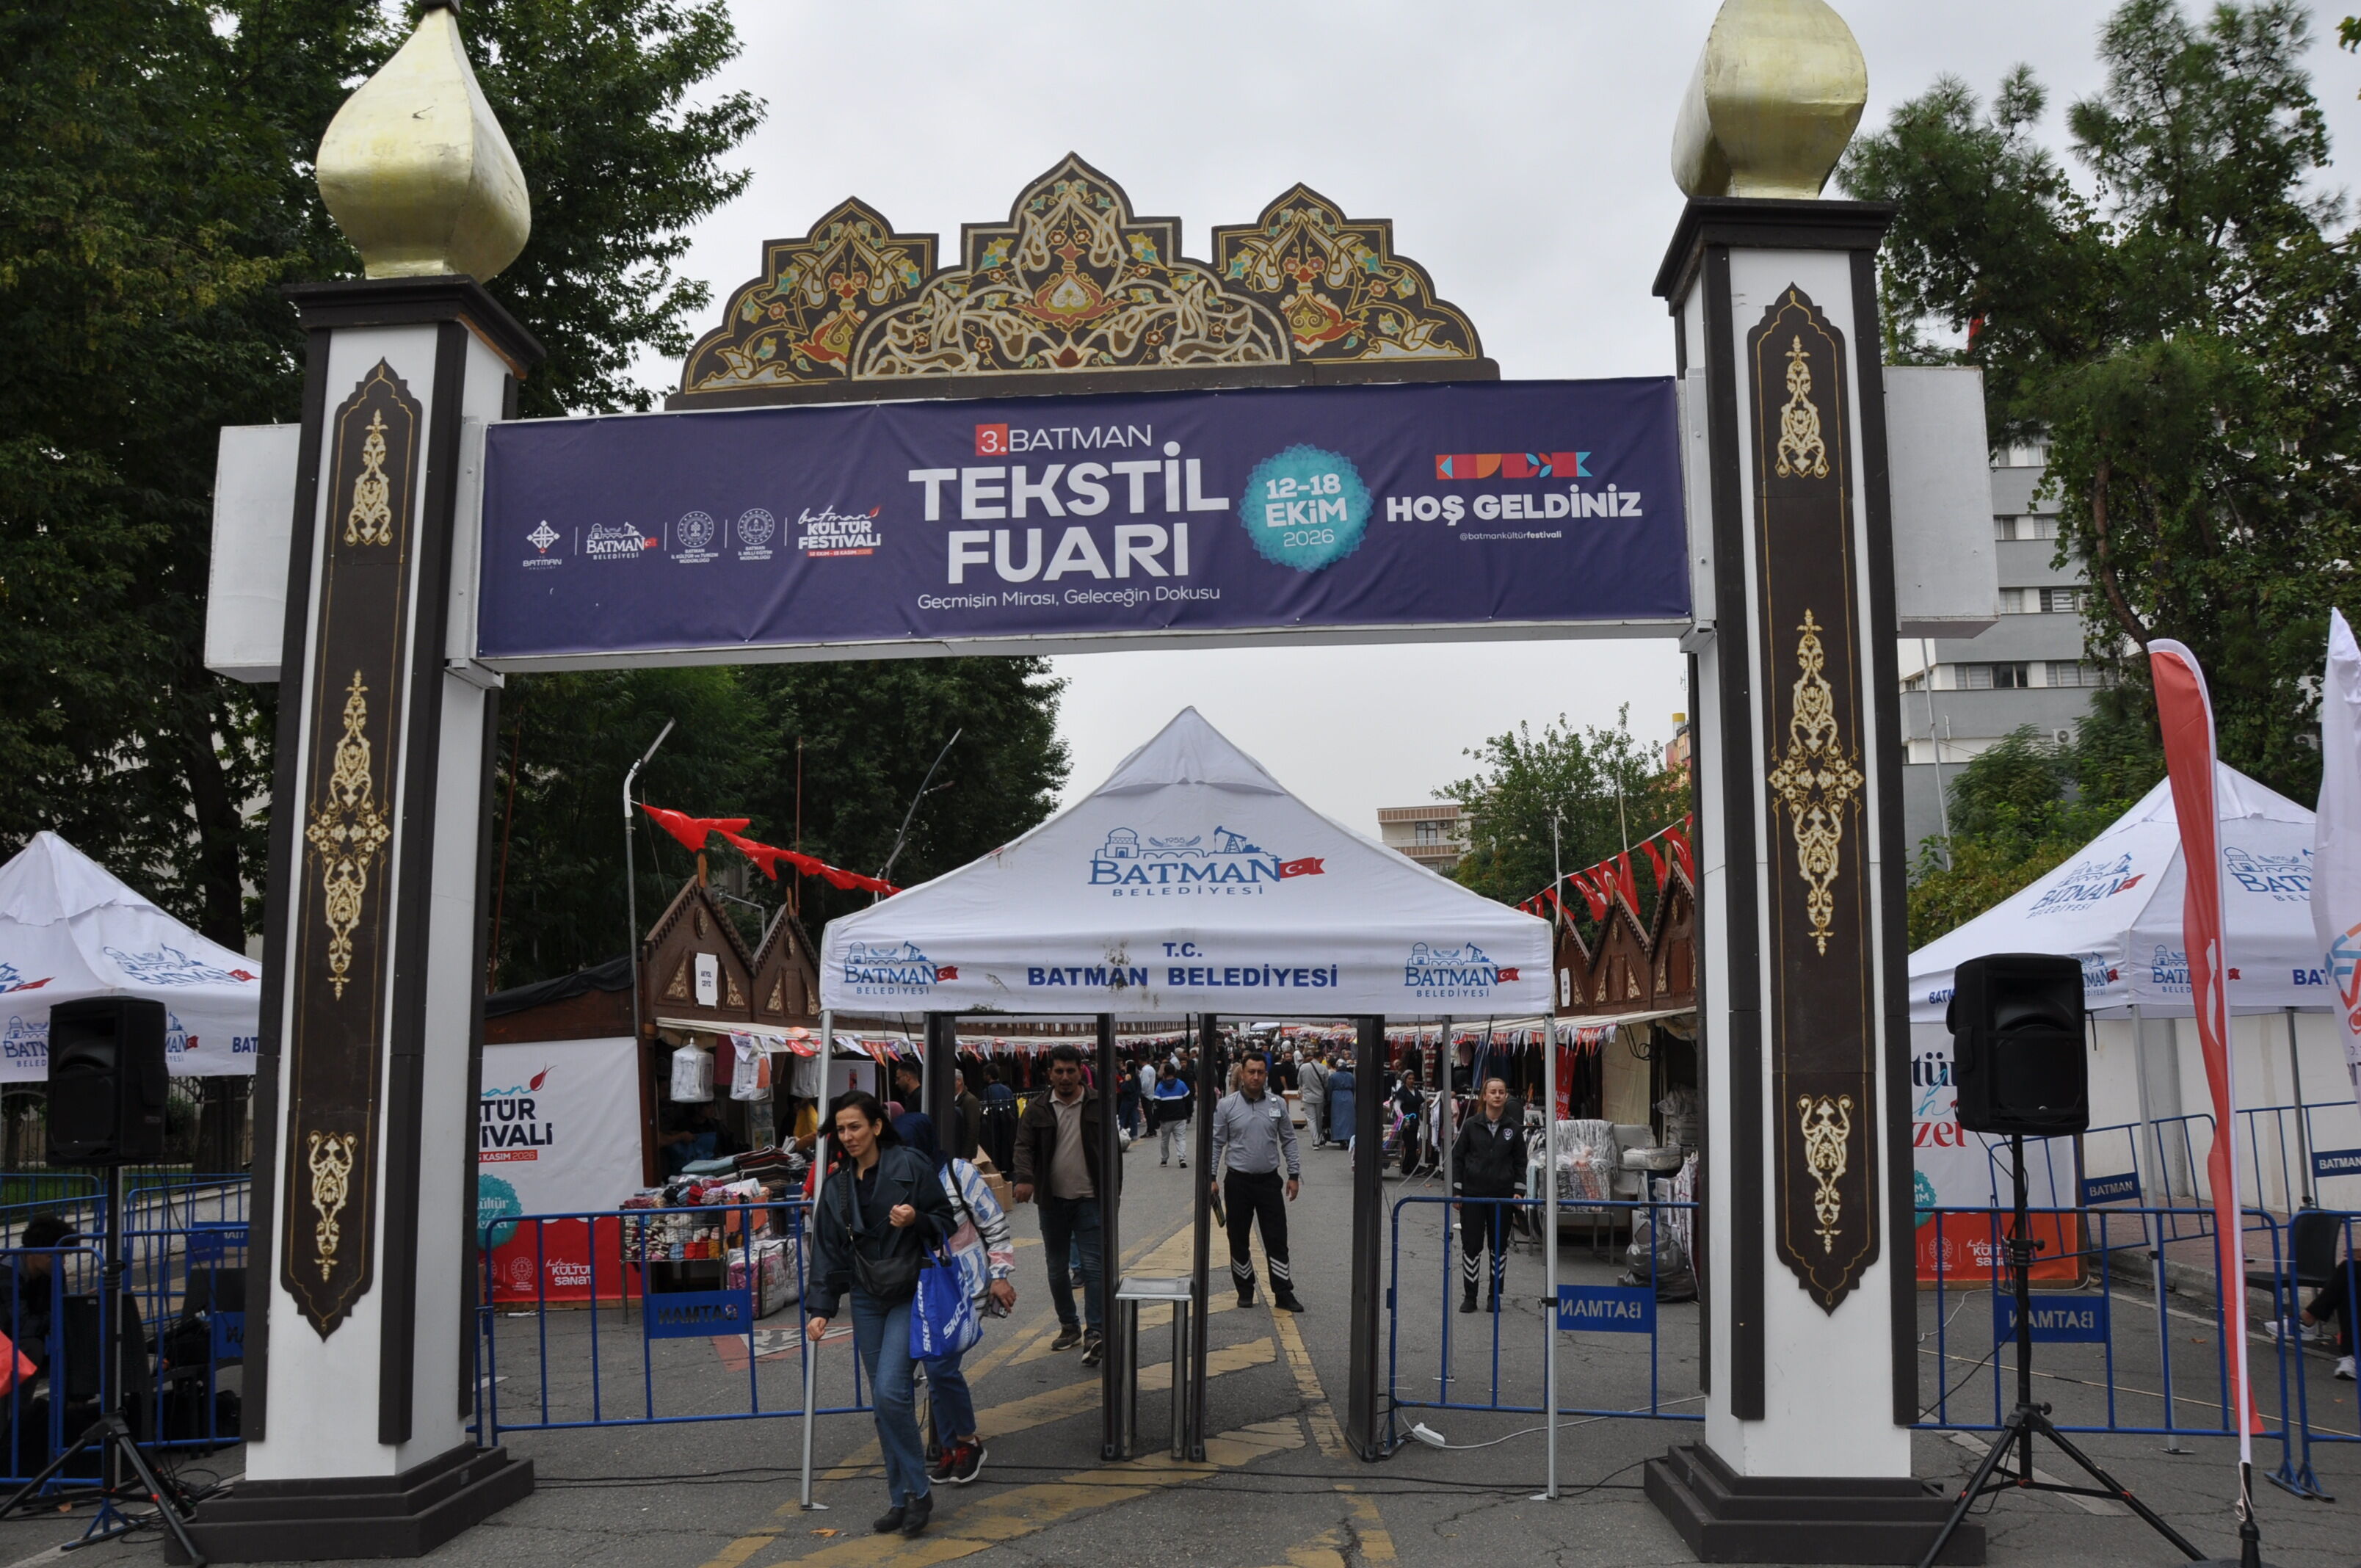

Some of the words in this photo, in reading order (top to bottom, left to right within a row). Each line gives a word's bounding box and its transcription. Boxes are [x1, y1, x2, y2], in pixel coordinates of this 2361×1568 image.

[909, 441, 1230, 520] TEKSTİL
[1266, 473, 1341, 499] 12-18
[1387, 495, 1465, 526] HOŞ
[1473, 483, 1642, 519] GELDİNİZ
[798, 505, 871, 524] batman
[808, 520, 872, 536] KÜLTÜR
[1459, 531, 1562, 540] @batmankültürfestivali
[586, 537, 645, 553] BATMAN
[1283, 529, 1334, 547] 2026
[948, 523, 1189, 584] FUARI
[523, 559, 562, 567] BATMAN
[918, 594, 996, 609] Geçmişin
[1002, 591, 1059, 606] Mirası,
[1065, 588, 1150, 607] Geleceğin
[1156, 586, 1220, 601] Dokusu
[1087, 858, 1282, 885] BATMAN
[2230, 872, 2312, 892] BAT
[1112, 885, 1263, 897] BELEDİYESİ
[2029, 878, 2129, 911] BATMAN
[1162, 942, 1203, 958] T.C.
[843, 965, 937, 984] BATMAN
[1027, 967, 1147, 987] BATMAN
[1168, 963, 1338, 987] BELEDİYESİ
[1404, 966, 1499, 986] BATMAN
[2151, 967, 2191, 984] BAT
[857, 987, 929, 995] BELEDİYESİ
[1416, 988, 1489, 998] BELEDİYESİ
[1929, 988, 1956, 1004] BATM
[233, 1037, 258, 1053] BAT
[17, 1059, 47, 1067] BELED
[481, 1098, 536, 1122] TÜR
[512, 1152, 535, 1160] 2026
[2089, 1180, 2133, 1197] BATMAN
[479, 1197, 509, 1209] ültür
